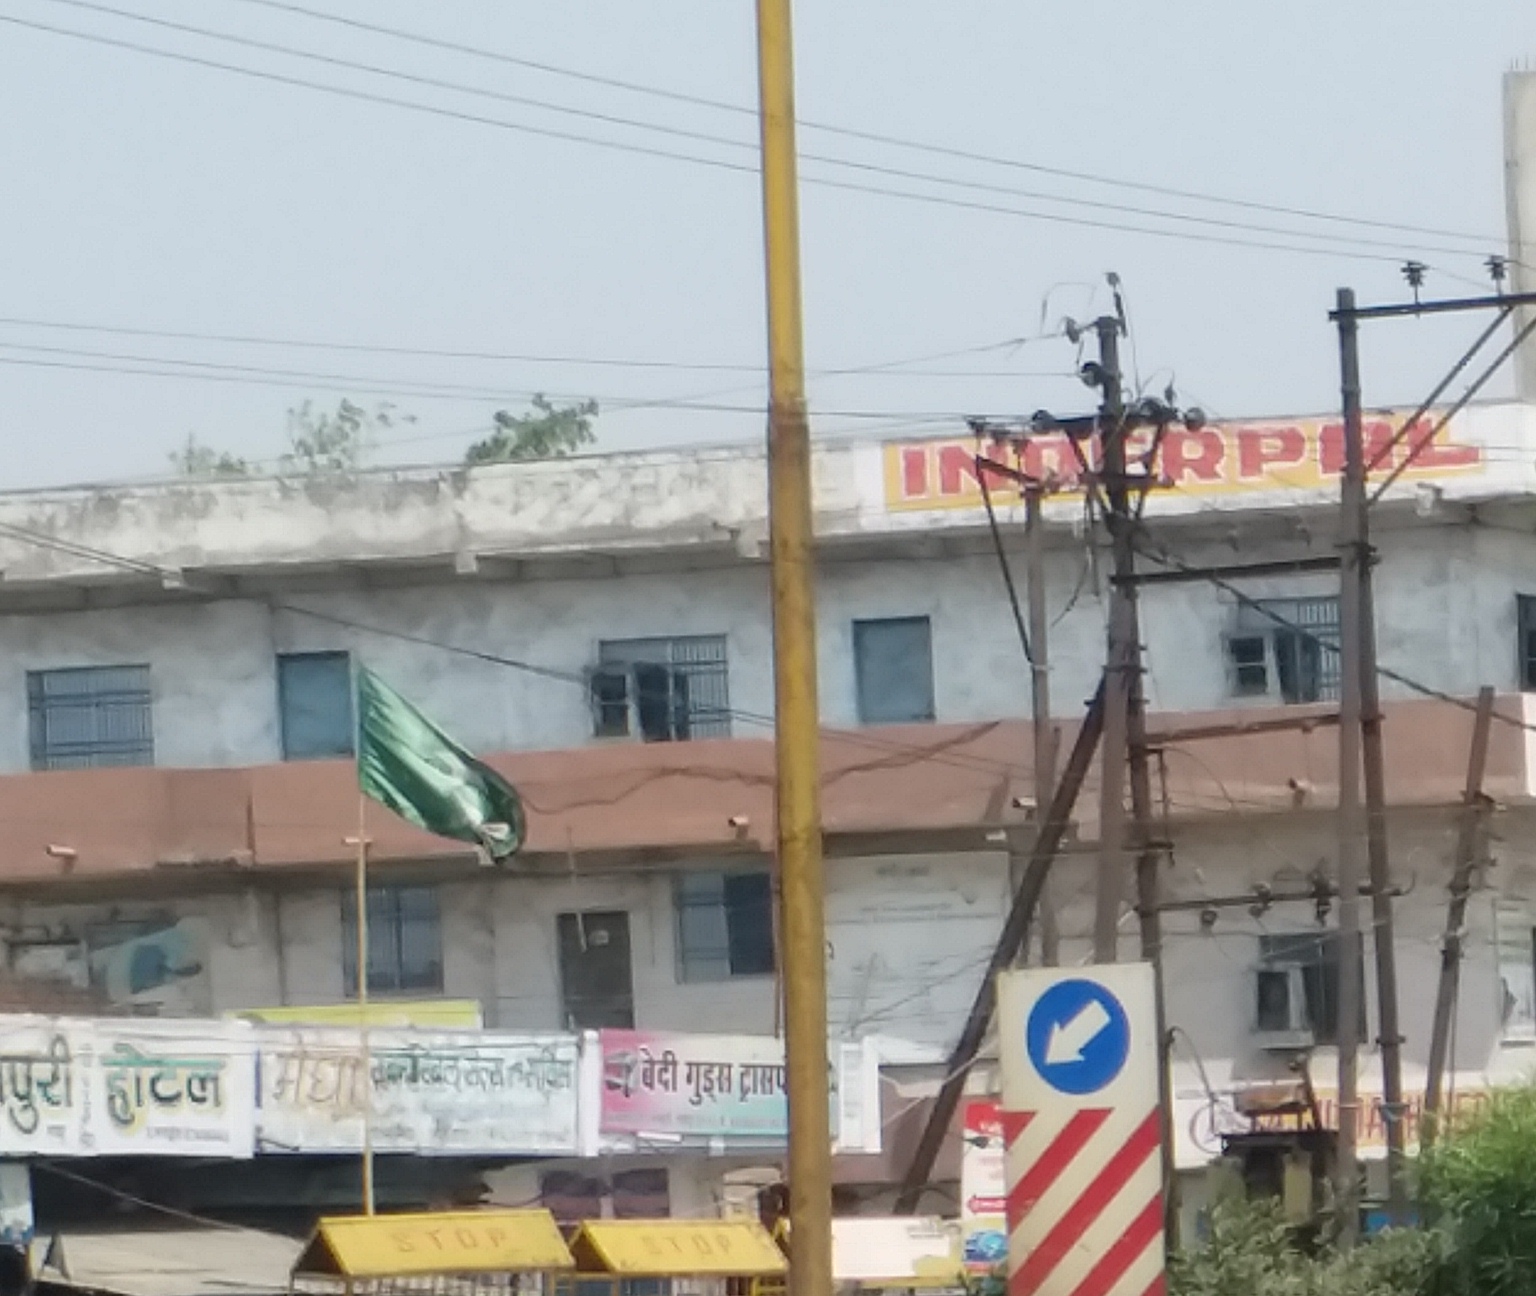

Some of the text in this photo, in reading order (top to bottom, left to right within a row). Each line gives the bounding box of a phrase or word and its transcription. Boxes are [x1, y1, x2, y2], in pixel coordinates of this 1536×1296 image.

[101, 1041, 226, 1126] होटल
[400, 1226, 510, 1254] STOP
[649, 1233, 732, 1256] STOP
